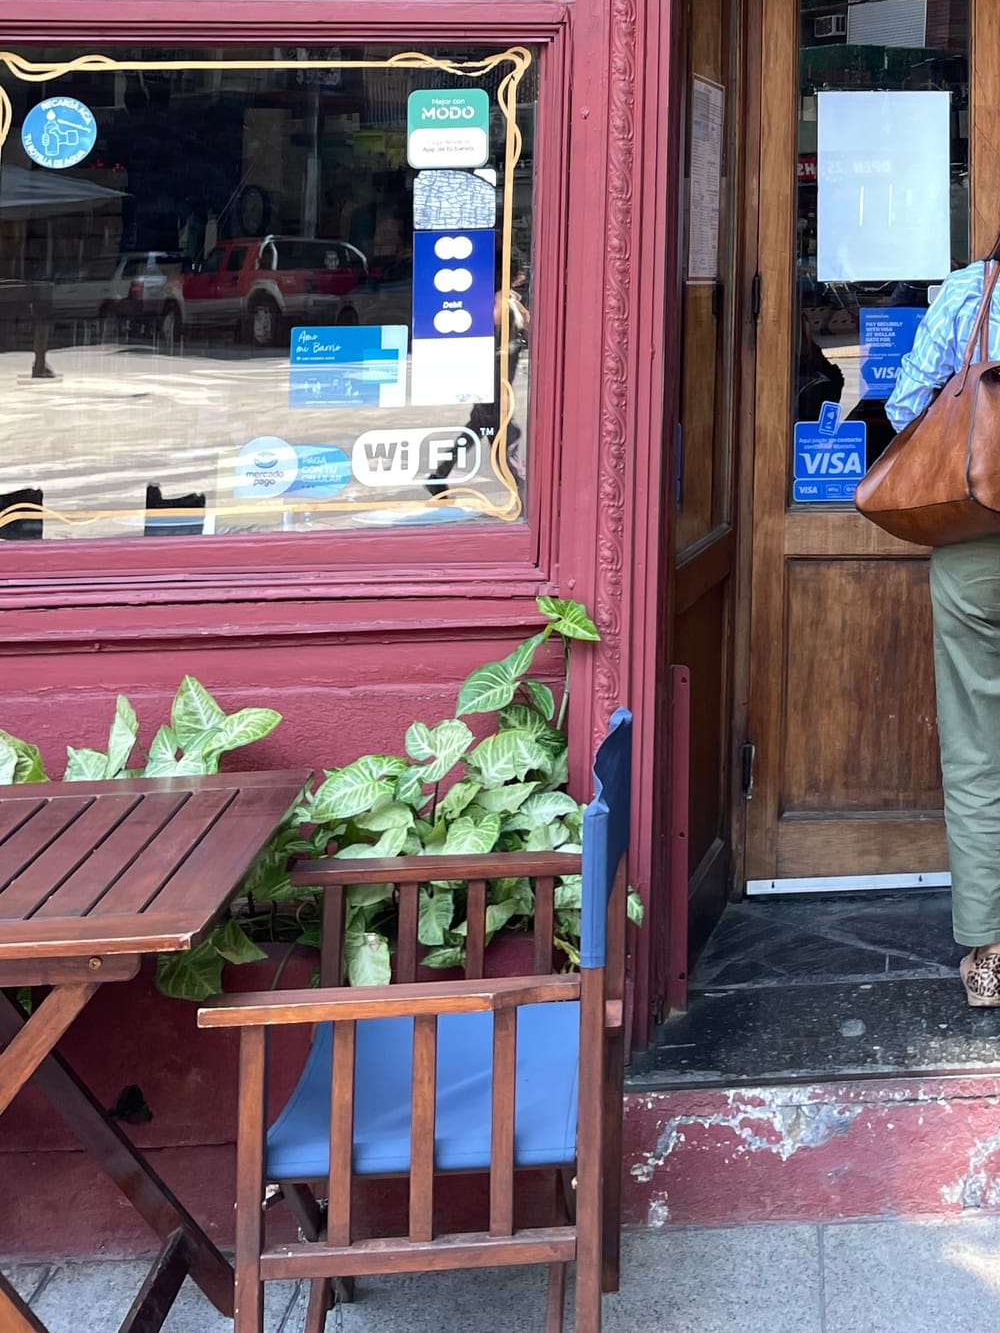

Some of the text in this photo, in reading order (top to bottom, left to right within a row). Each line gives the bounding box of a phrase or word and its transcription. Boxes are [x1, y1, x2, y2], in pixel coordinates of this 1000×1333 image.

[432, 98, 451, 106] Mejor
[421, 106, 475, 120] MODO
[313, 342, 342, 354] Barrio
[798, 452, 862, 474] VISA
[245, 470, 284, 478] mercado
[253, 478, 276, 487] pago
[799, 486, 818, 495] VISA
